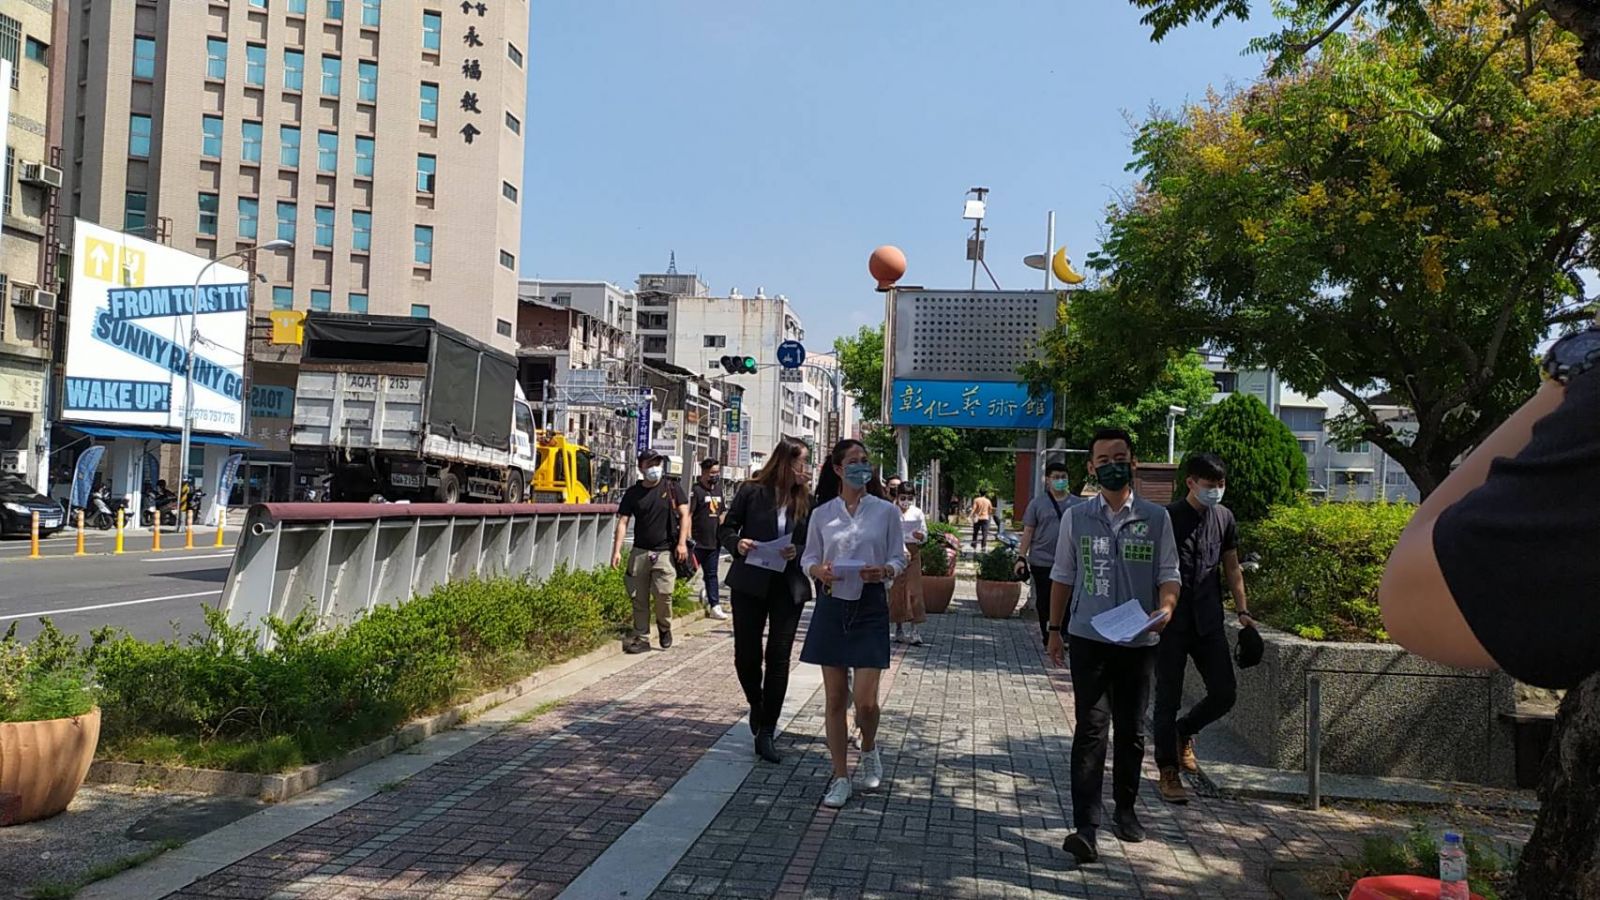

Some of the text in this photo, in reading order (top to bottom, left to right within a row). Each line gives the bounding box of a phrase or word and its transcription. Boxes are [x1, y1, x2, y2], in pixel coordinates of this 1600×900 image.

[113, 289, 171, 319] FROM
[173, 286, 229, 315] TOAST
[97, 311, 169, 365] SUNNY
[168, 345, 224, 390] RAINY
[67, 378, 132, 409] WAKE
[136, 382, 169, 410] UP!
[899, 385, 1047, 420] 彰化藝術館
[1092, 535, 1111, 598] 楊子賢
